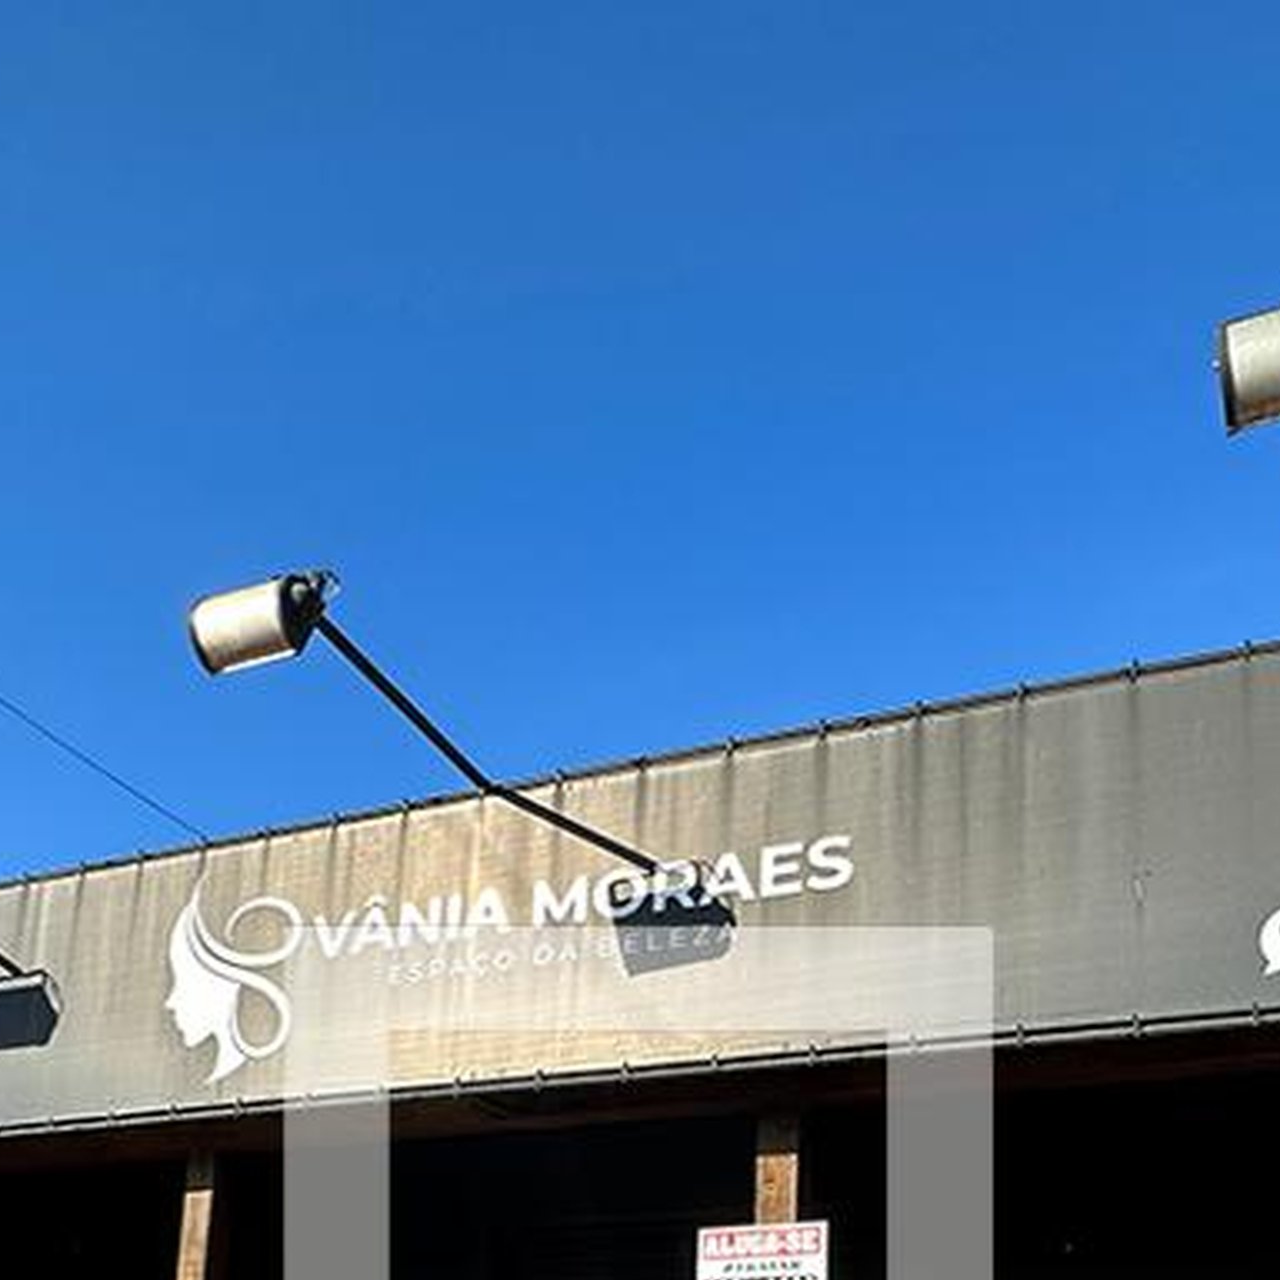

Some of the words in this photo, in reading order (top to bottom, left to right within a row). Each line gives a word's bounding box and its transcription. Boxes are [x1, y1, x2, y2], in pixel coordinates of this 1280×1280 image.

[312, 884, 514, 961] VÂNIA
[532, 833, 855, 928] MORAES
[532, 942, 579, 967] DA
[596, 922, 737, 960] BELEZA
